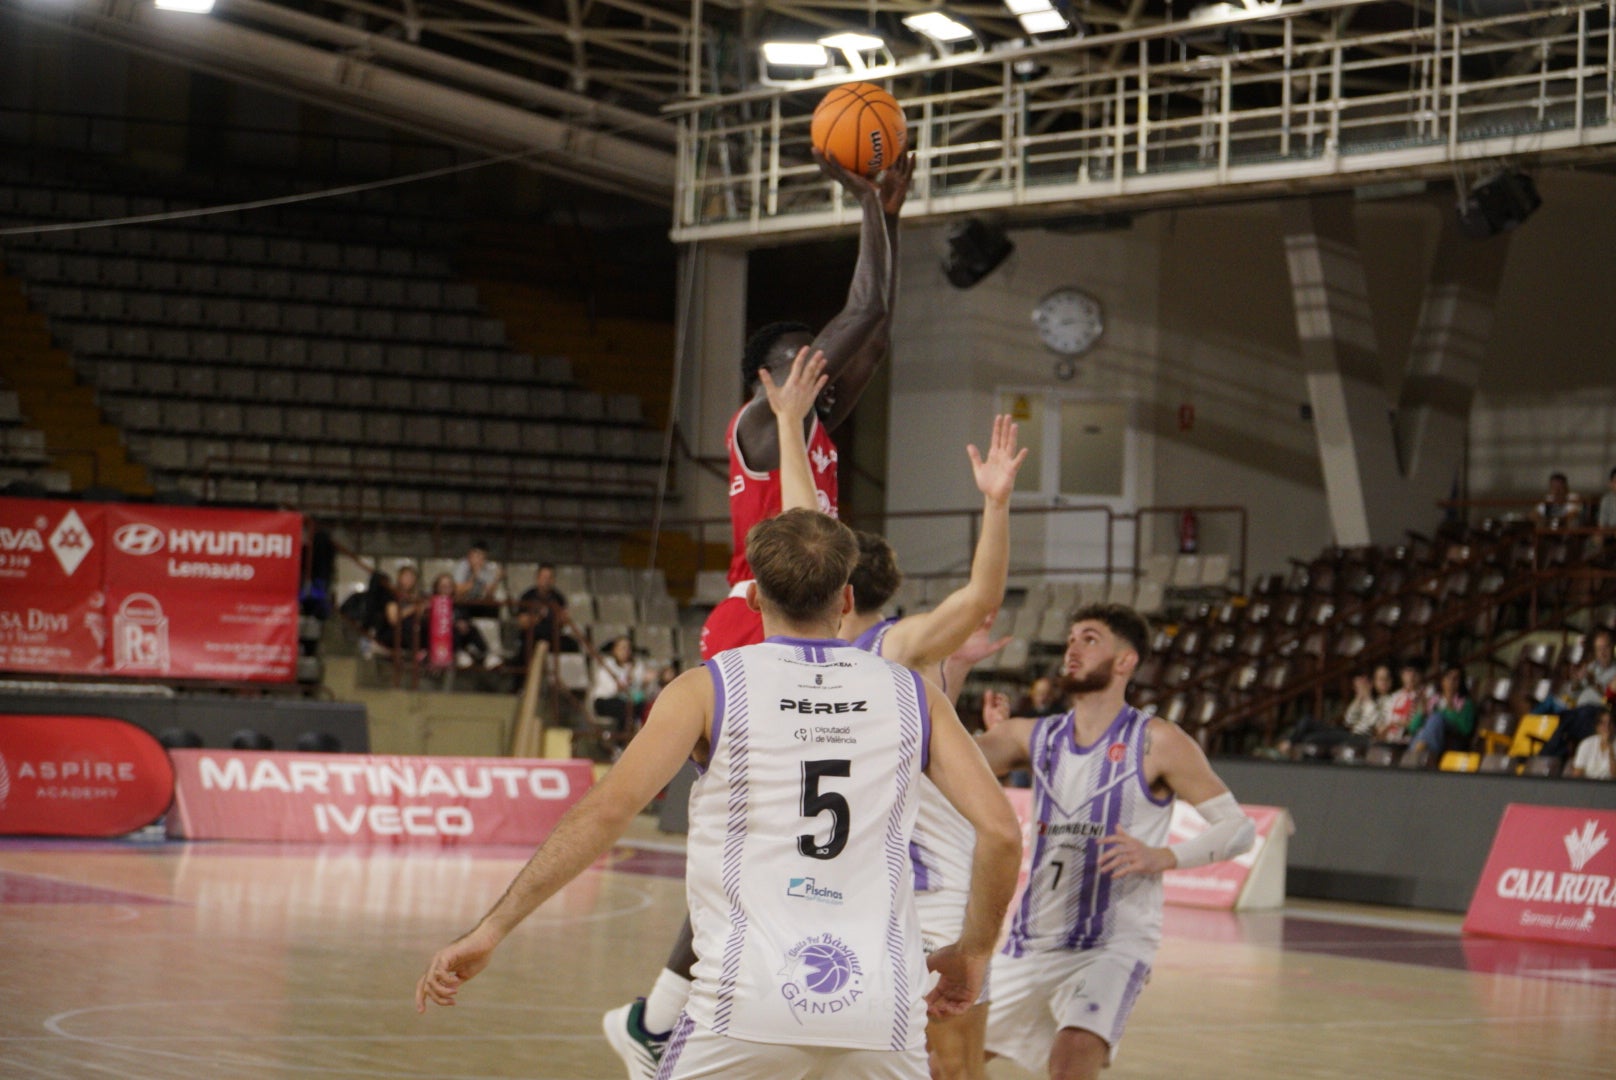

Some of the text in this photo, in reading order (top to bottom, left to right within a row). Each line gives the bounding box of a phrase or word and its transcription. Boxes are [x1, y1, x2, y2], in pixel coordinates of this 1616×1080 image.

[169, 529, 293, 558] HYUNDAI
[168, 558, 255, 581] Lemauto
[780, 698, 868, 714] PÉREZ
[198, 756, 571, 800] MARTINAUTO
[314, 803, 475, 837] IVECO
[796, 759, 852, 861] 5
[1050, 860, 1064, 891] 7
[1497, 867, 1616, 909] CAJA RUR
[805, 883, 844, 901] Piscinas
[781, 981, 865, 1015] GANDIA
